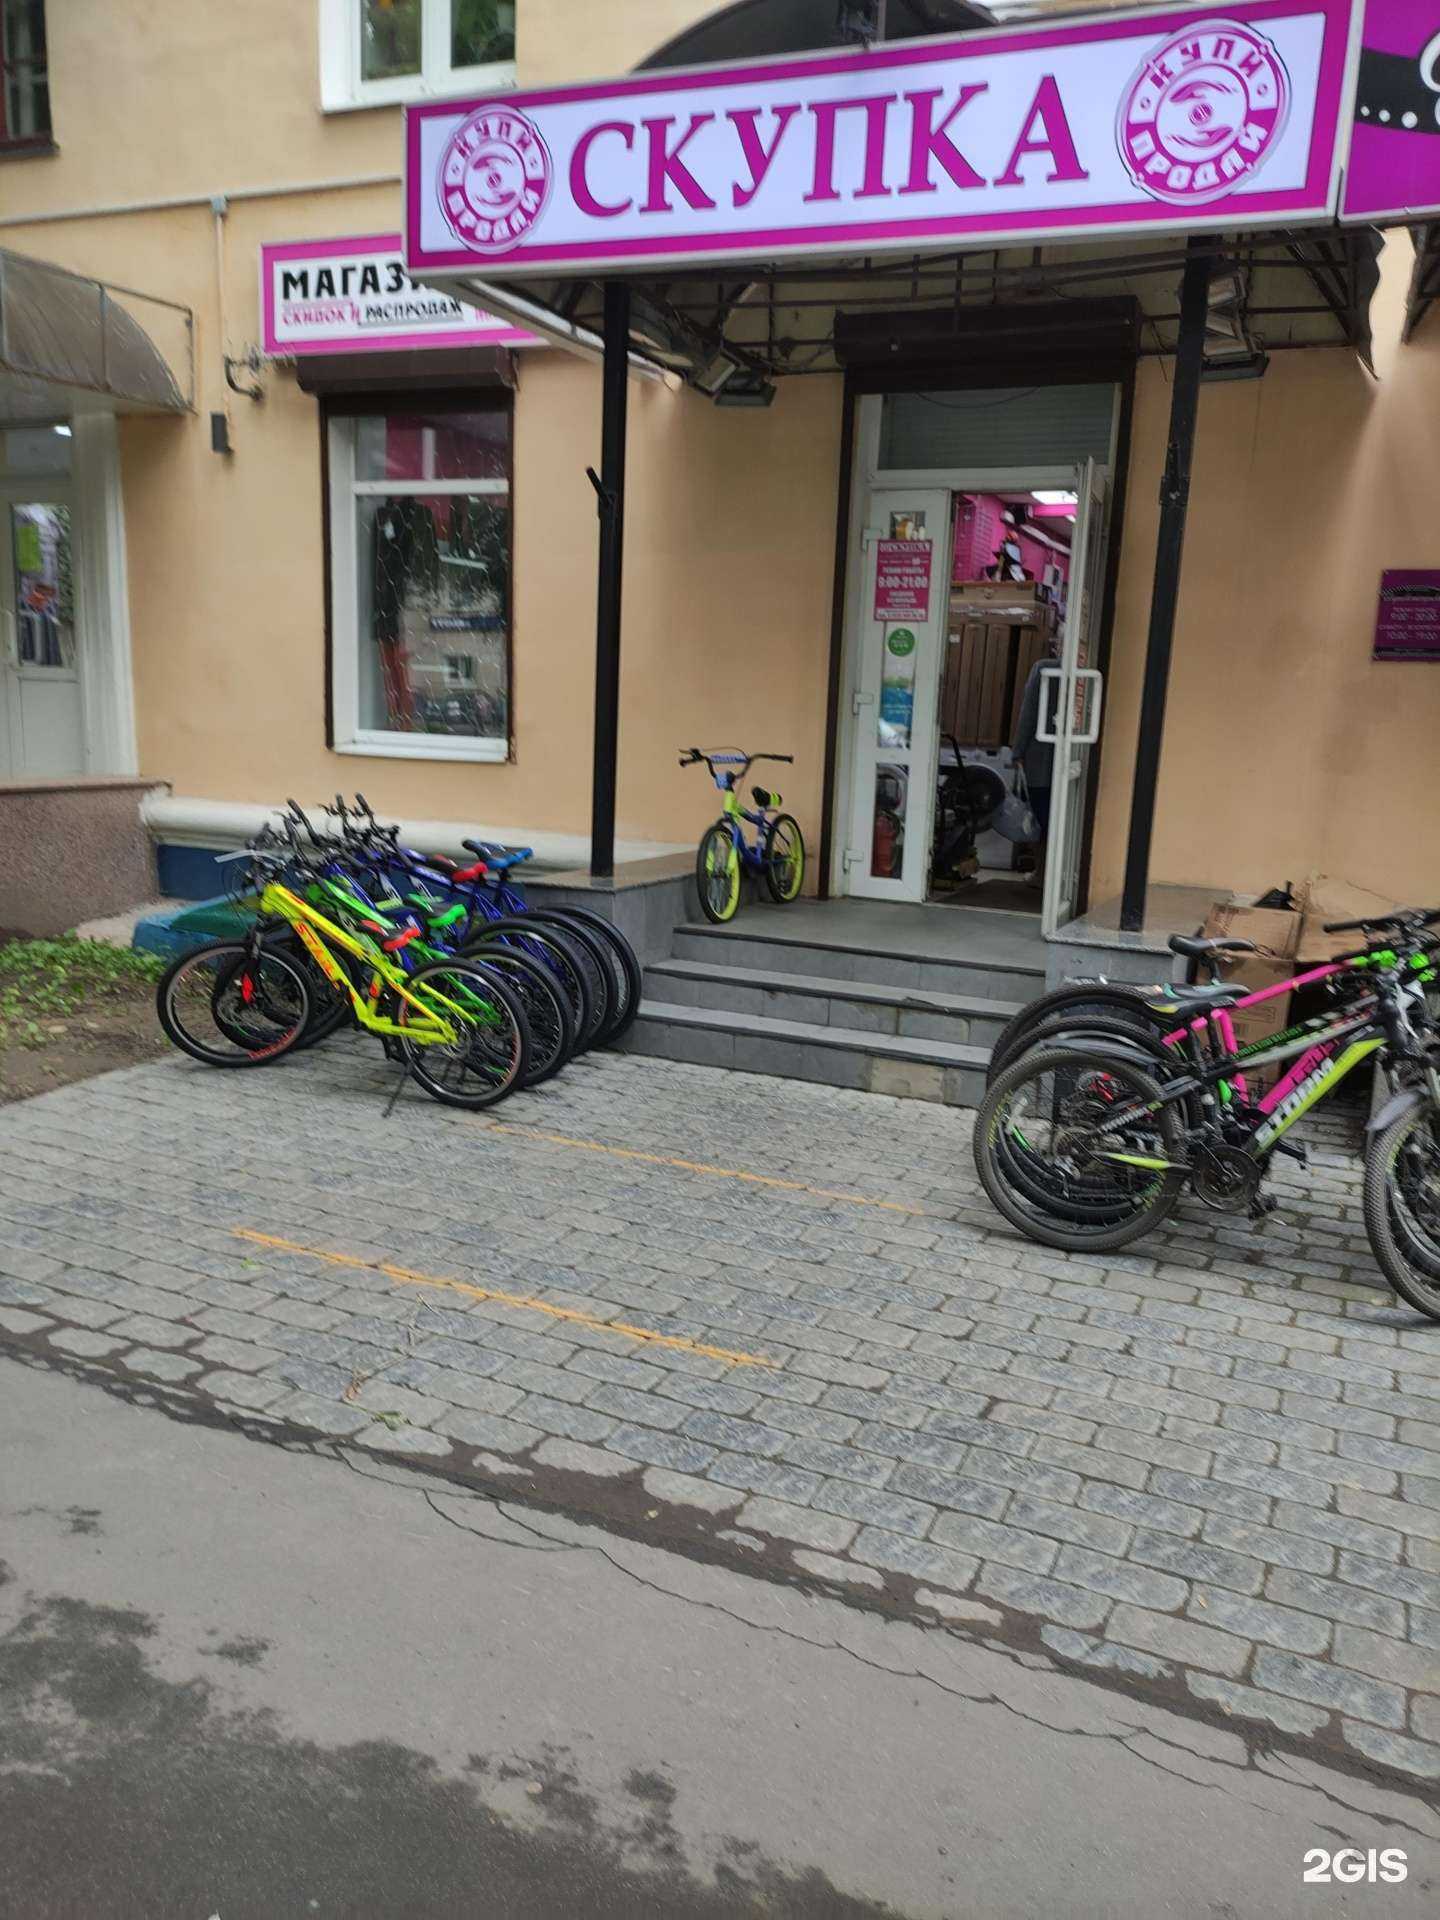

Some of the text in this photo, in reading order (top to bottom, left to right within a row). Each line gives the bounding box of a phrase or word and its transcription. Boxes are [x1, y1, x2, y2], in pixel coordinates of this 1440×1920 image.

[1149, 36, 1266, 90] КУПИ
[567, 74, 1090, 218] СКУПКА
[282, 262, 428, 300] МАГАЗ
